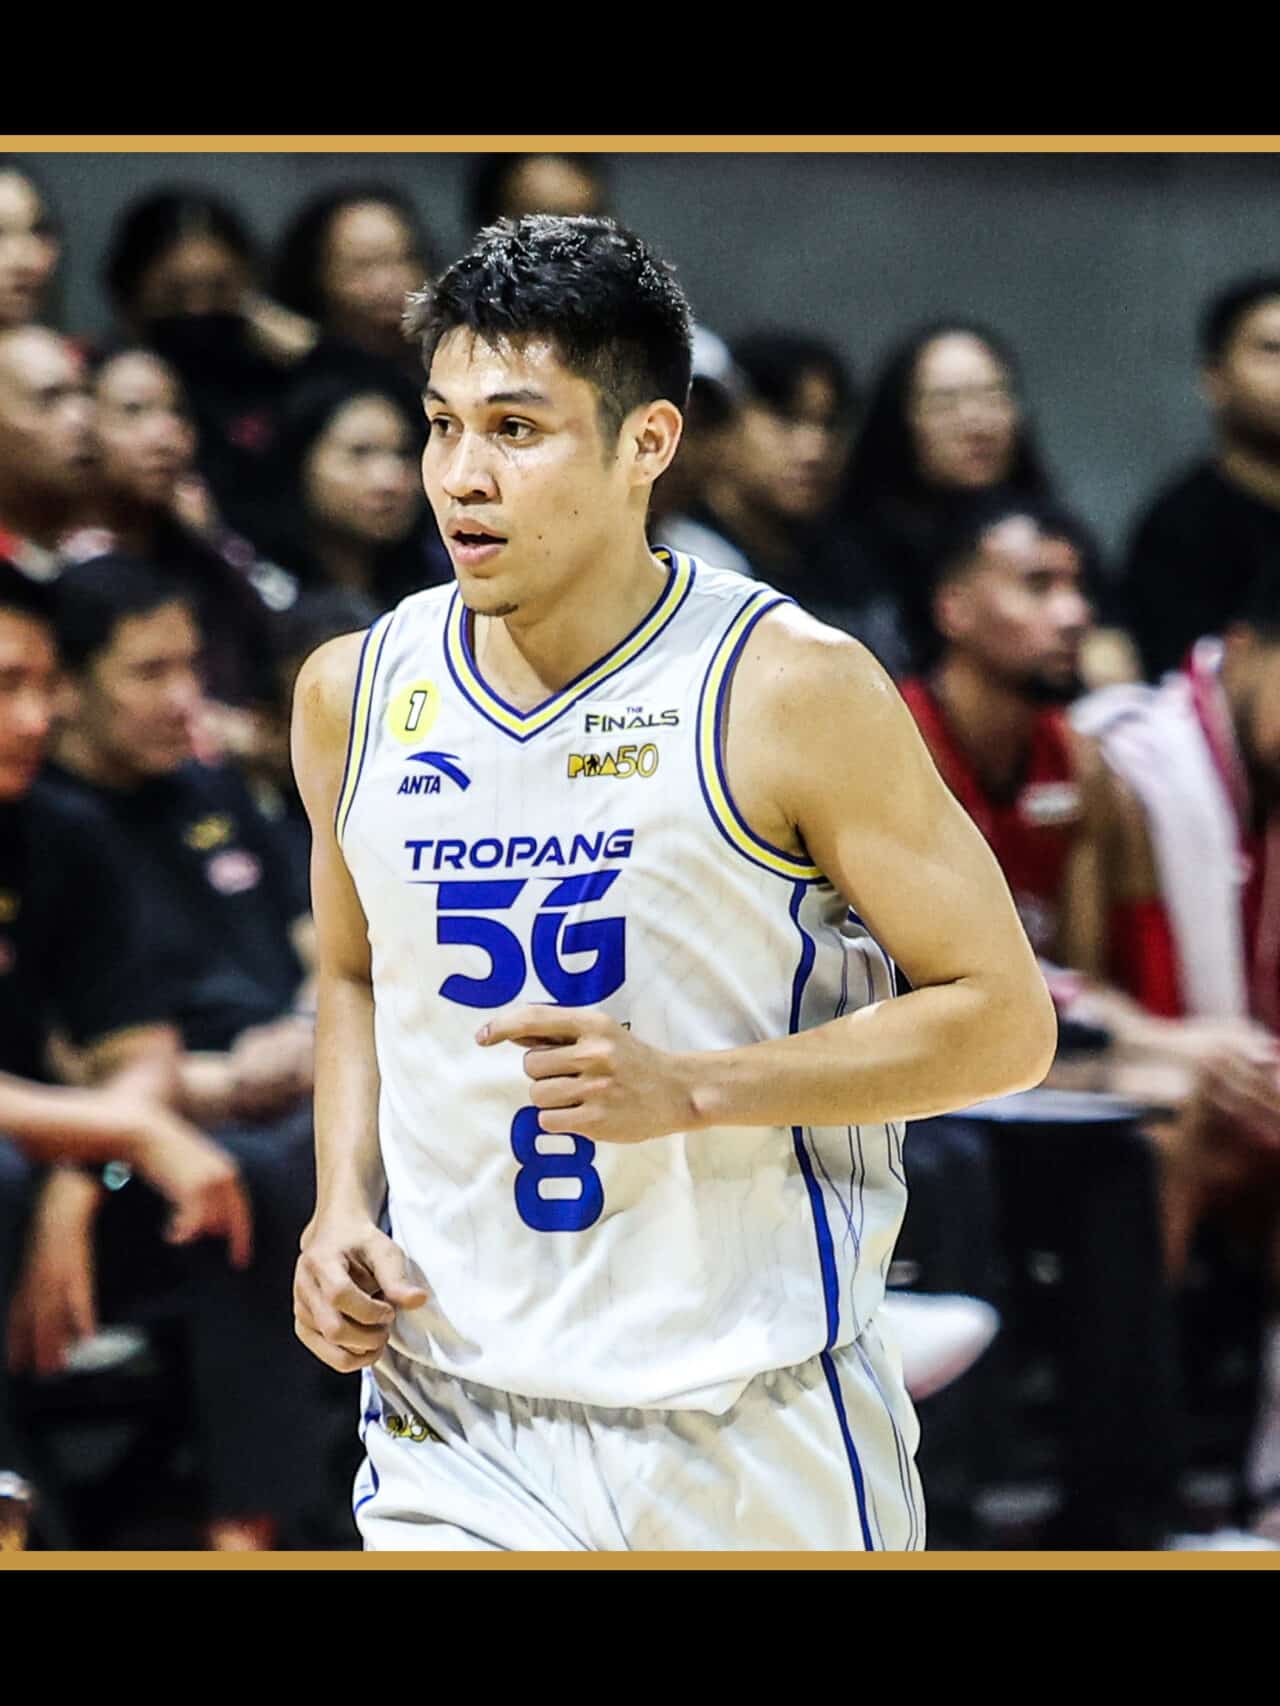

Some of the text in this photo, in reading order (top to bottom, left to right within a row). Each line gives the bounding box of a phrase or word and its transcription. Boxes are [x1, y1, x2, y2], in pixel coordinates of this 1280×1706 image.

[584, 708, 680, 733] FINALS
[397, 775, 441, 795] ANTA
[404, 829, 635, 871] TROPANG
[408, 869, 627, 1009] 5G
[510, 1105, 605, 1232] 8
